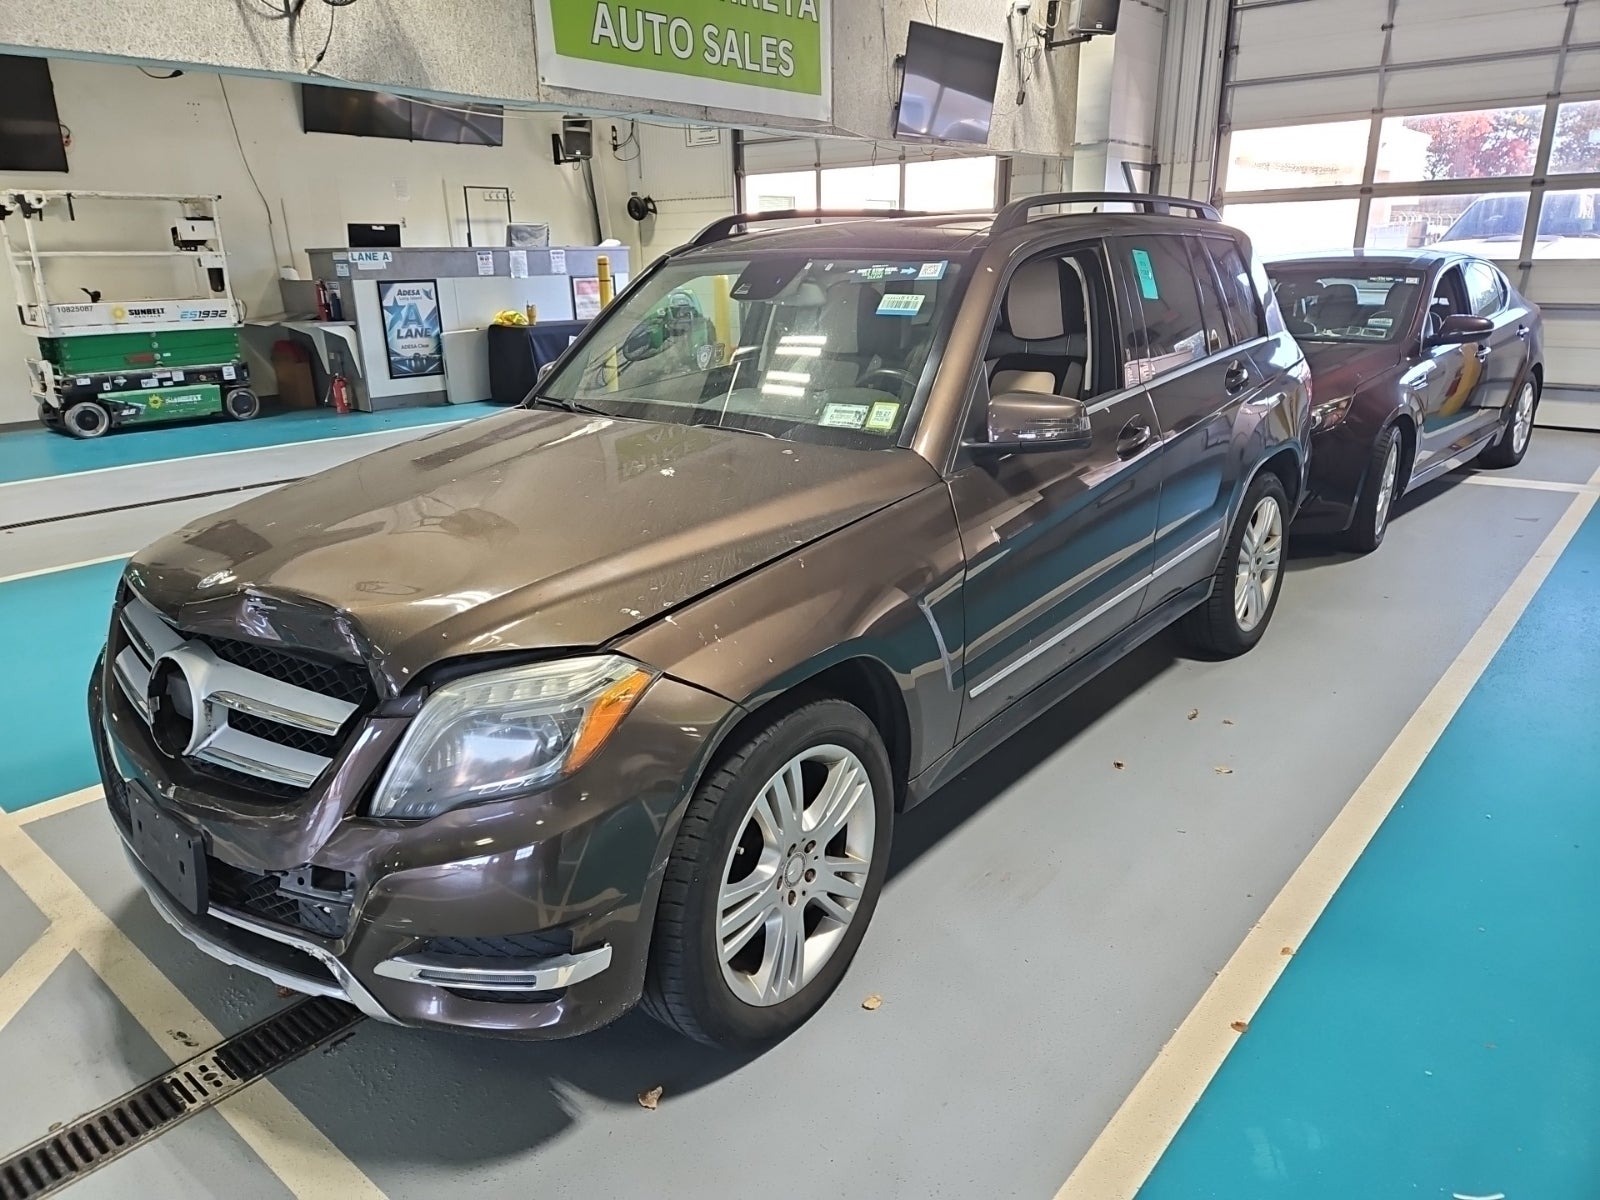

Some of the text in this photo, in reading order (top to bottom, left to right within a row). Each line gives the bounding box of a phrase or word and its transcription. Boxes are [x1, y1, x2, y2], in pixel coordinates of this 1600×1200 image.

[591, 1, 796, 78] AUTO SALES
[351, 252, 379, 261] LANE
[382, 252, 390, 261] A
[128, 307, 228, 318] SUNBELT ES1932
[401, 303, 424, 329] A
[396, 328, 431, 339] LANE
